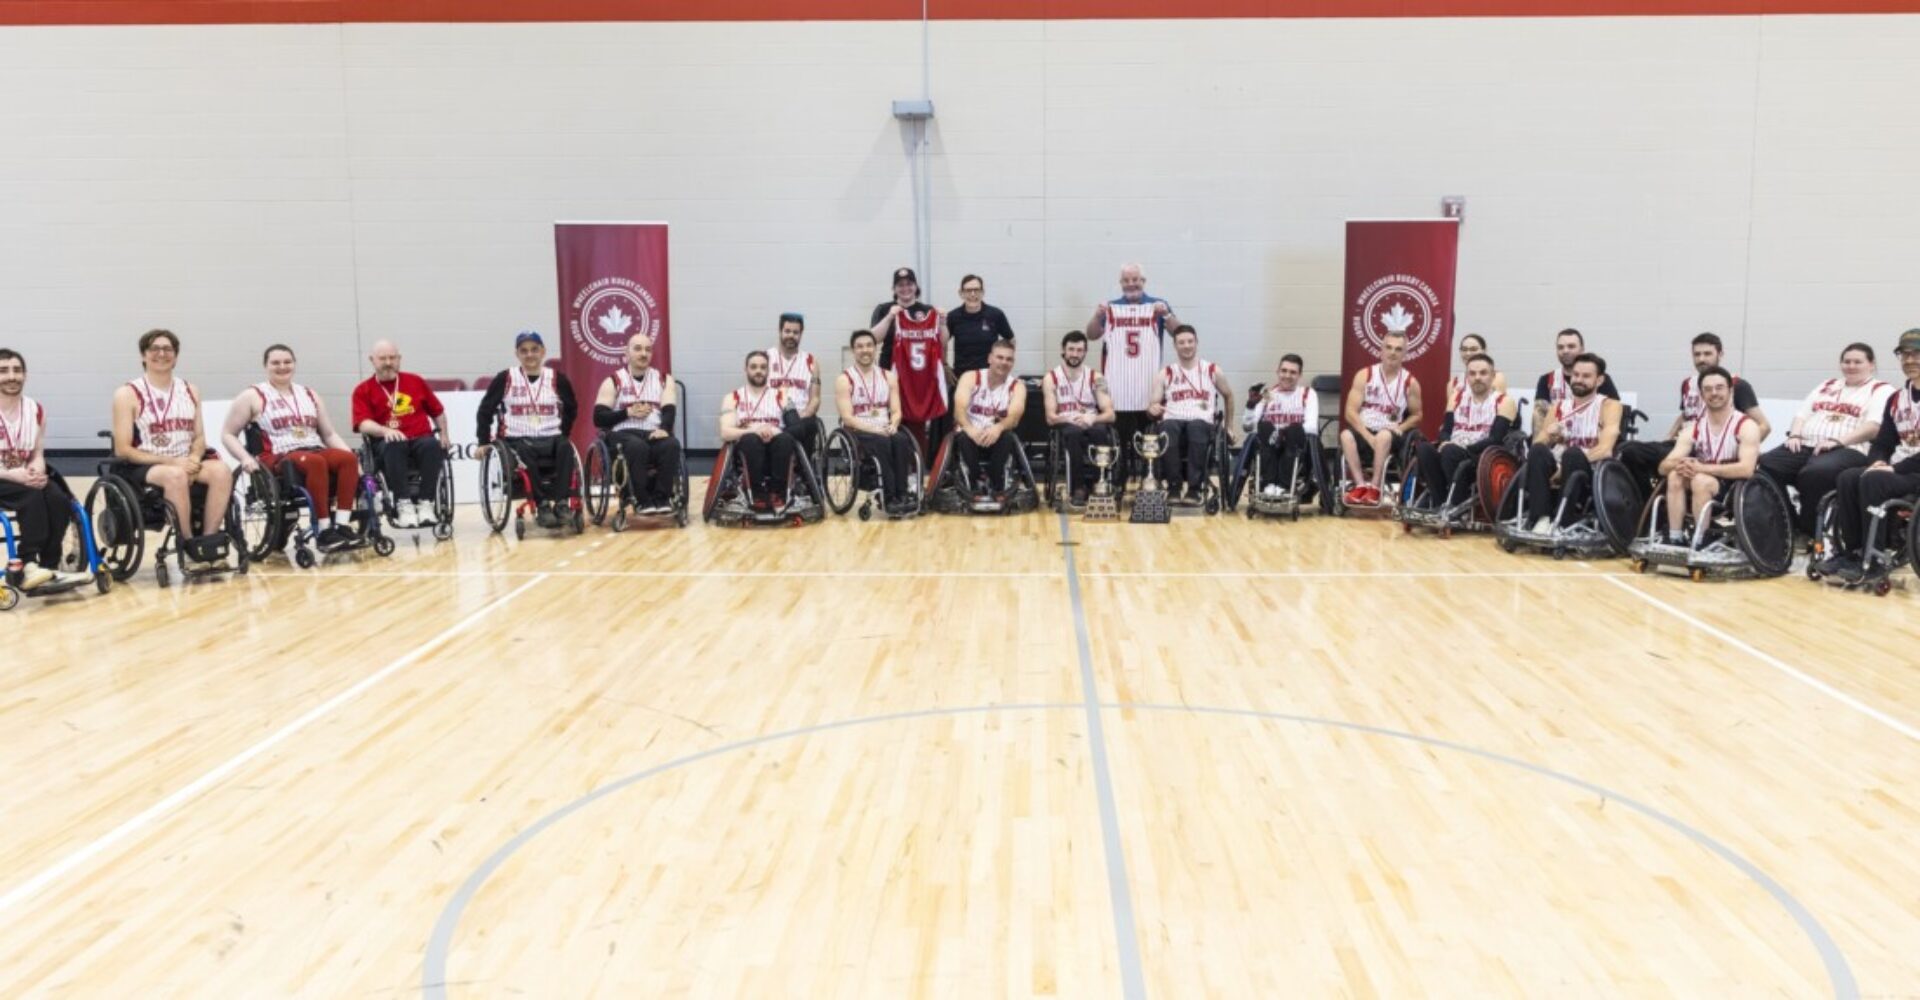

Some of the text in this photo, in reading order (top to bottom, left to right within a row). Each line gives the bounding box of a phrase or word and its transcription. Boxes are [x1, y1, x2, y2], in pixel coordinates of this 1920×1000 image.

[611, 277, 635, 289] RUGBY
[1396, 274, 1421, 287] RUGBY
[1125, 331, 1140, 358] 5
[910, 342, 927, 370] 5
